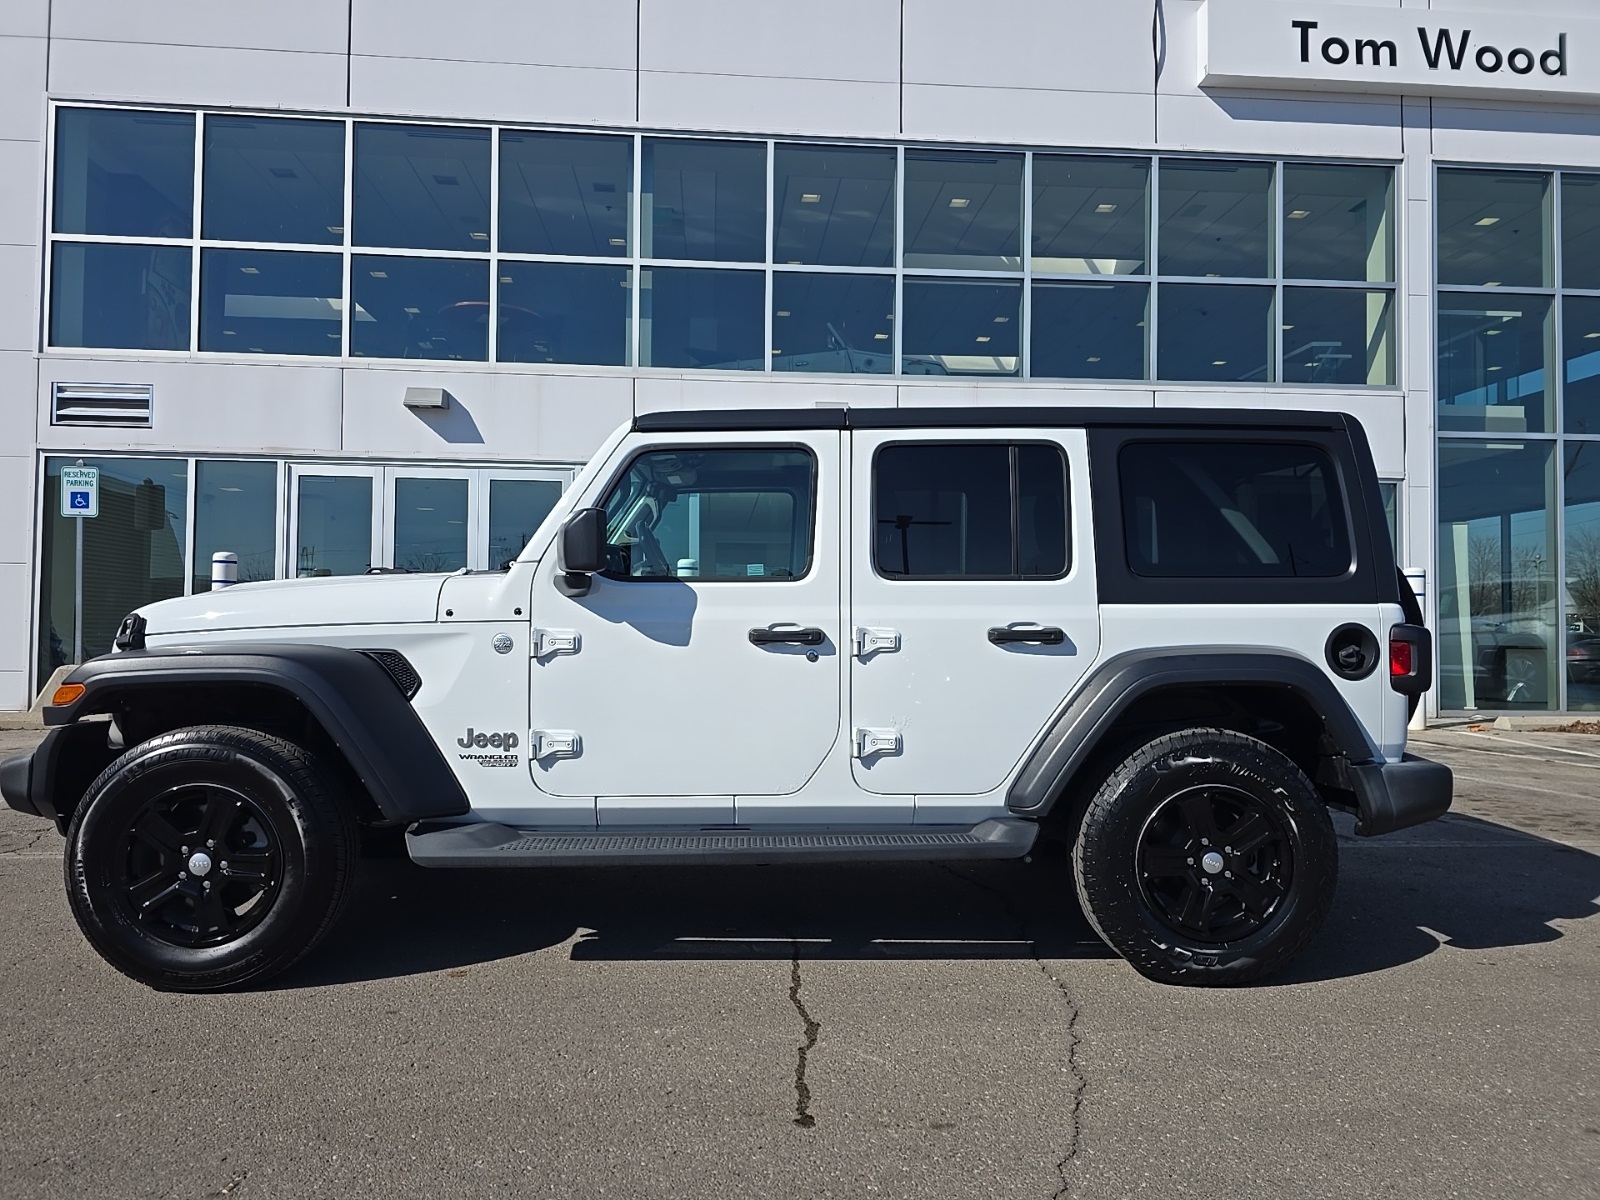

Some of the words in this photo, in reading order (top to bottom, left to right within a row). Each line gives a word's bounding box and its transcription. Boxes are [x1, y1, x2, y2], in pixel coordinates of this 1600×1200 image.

[1292, 20, 1398, 67] Tom
[1417, 26, 1568, 76] Wood
[457, 727, 519, 752] Jeep
